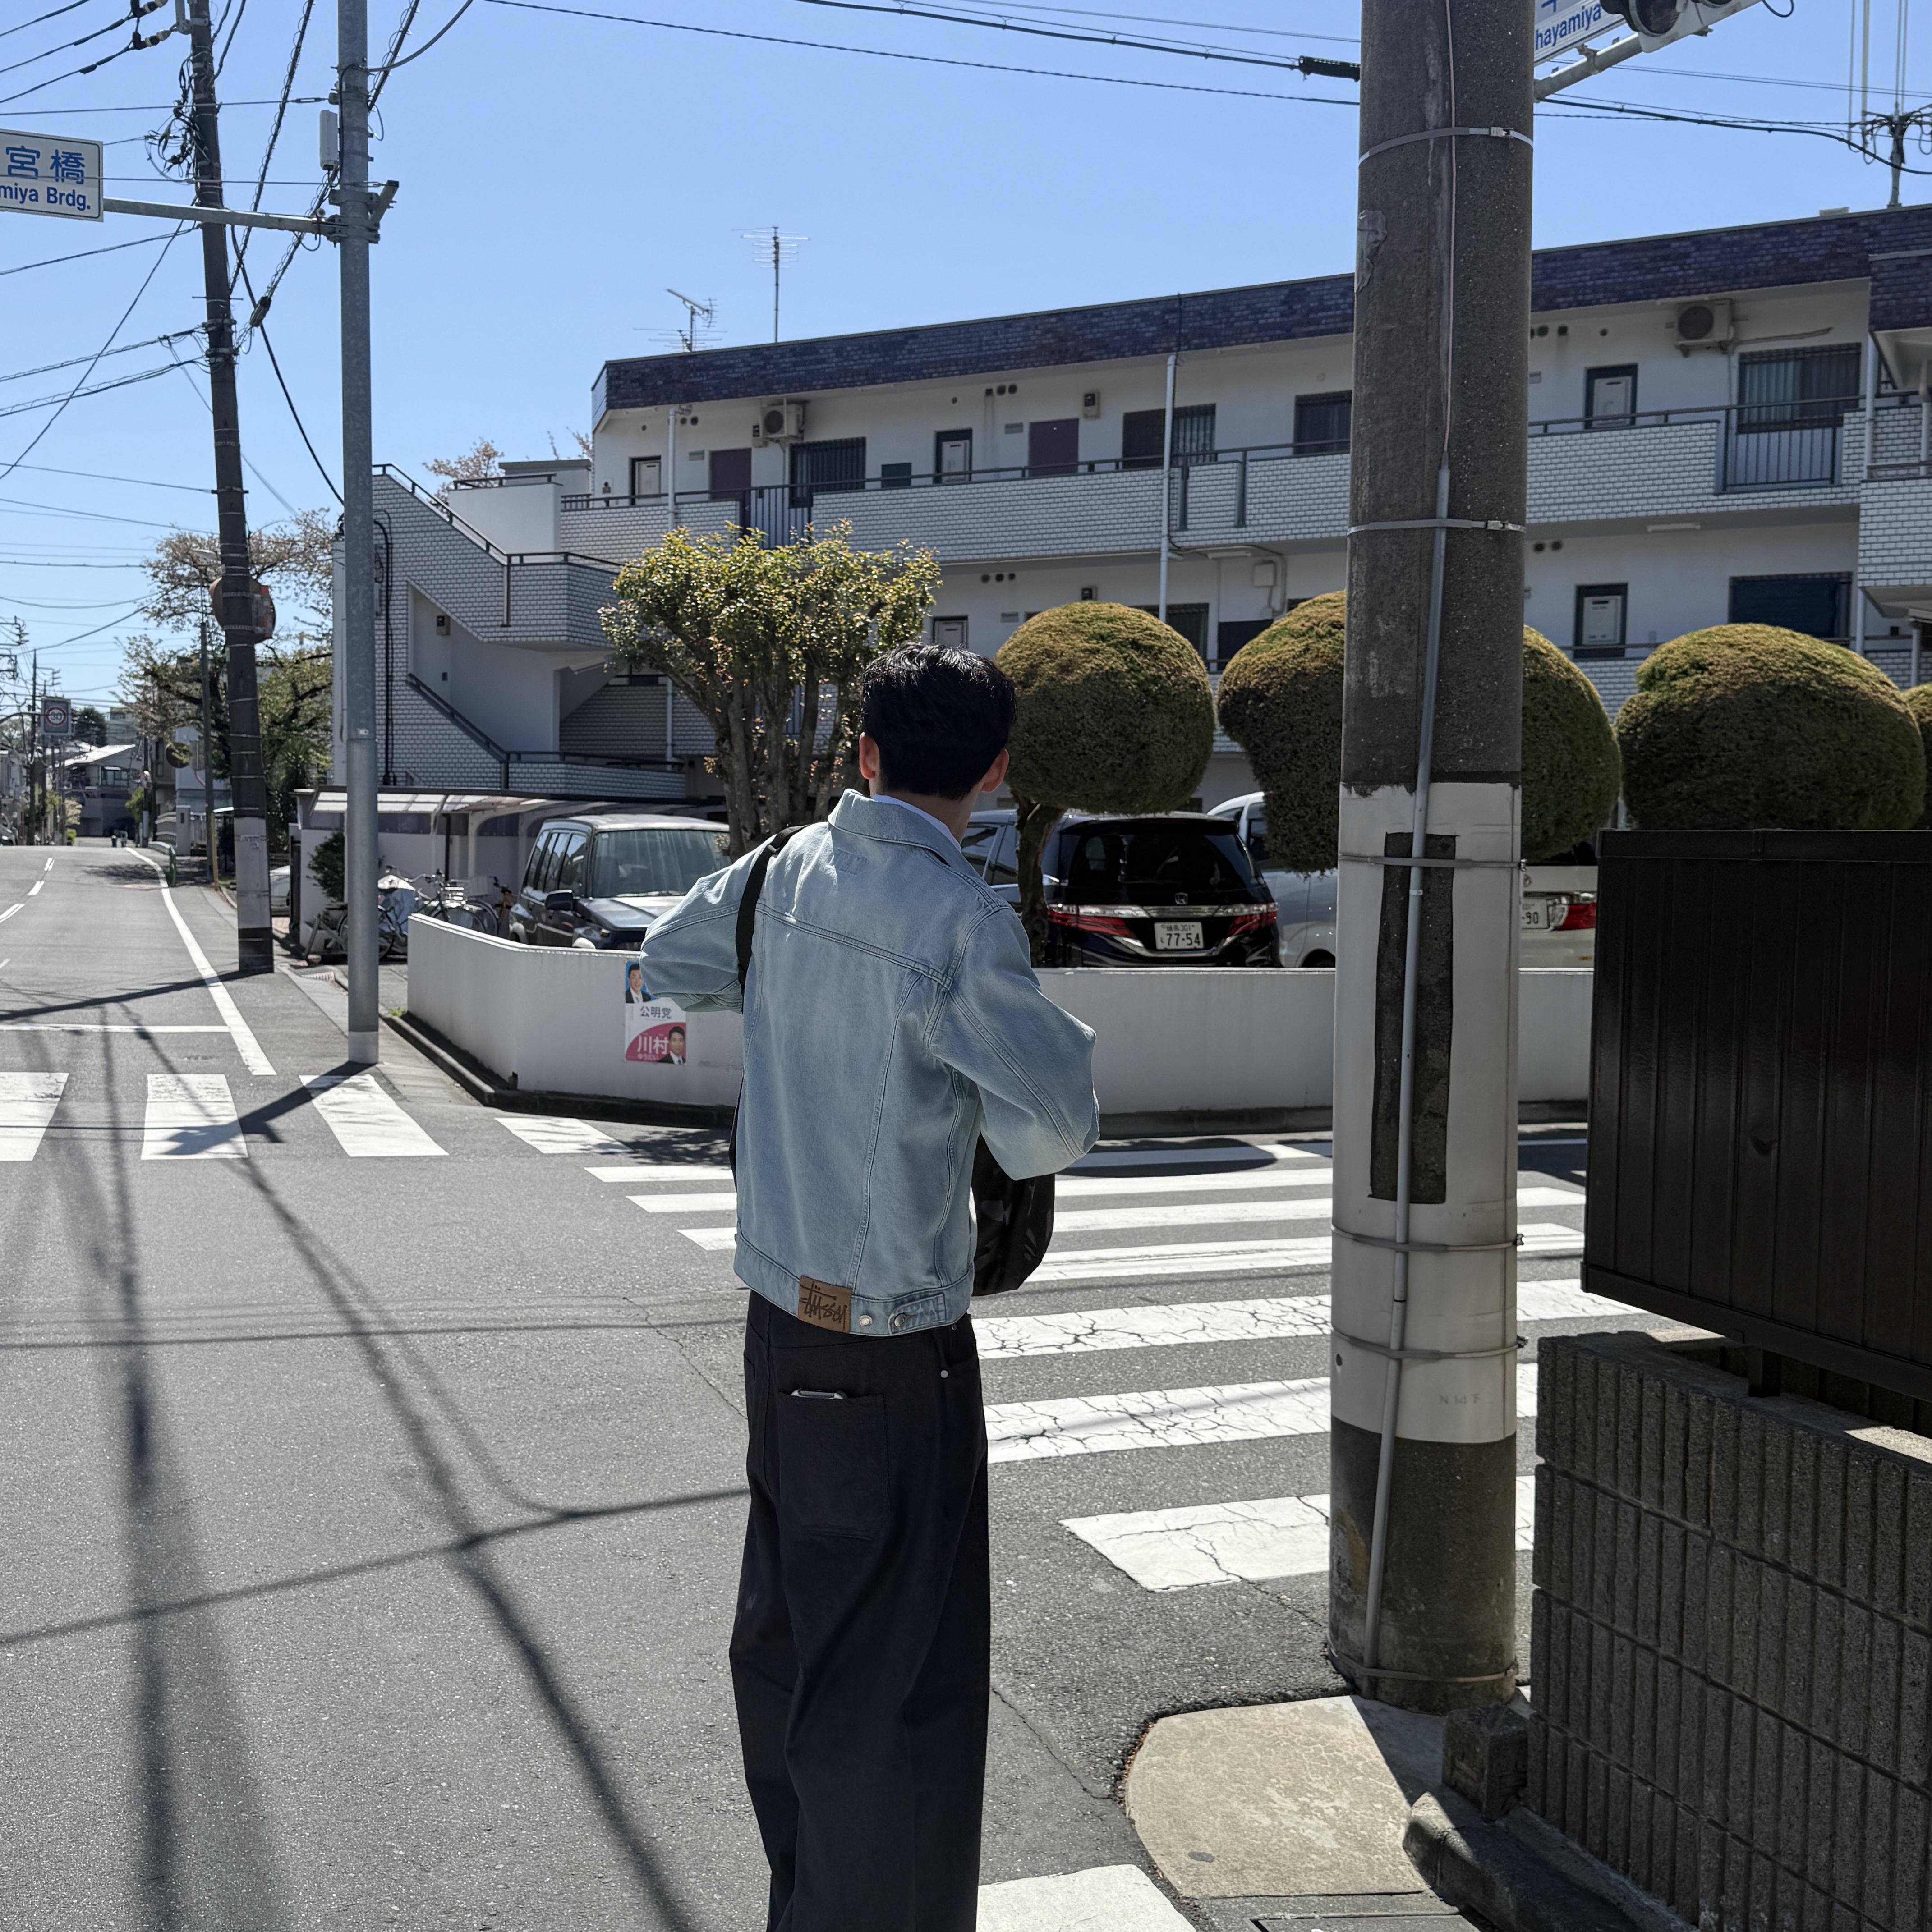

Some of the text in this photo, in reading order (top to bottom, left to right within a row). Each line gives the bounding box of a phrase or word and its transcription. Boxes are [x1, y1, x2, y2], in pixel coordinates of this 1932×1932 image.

[1536, 4, 1601, 50] hayamiya
[6, 145, 85, 184] 宮橋
[0, 183, 91, 211] miya Brdg.
[1166, 932, 1200, 946] 77-54
[640, 1006, 671, 1019] 公明党
[637, 1035, 669, 1055] 川村
